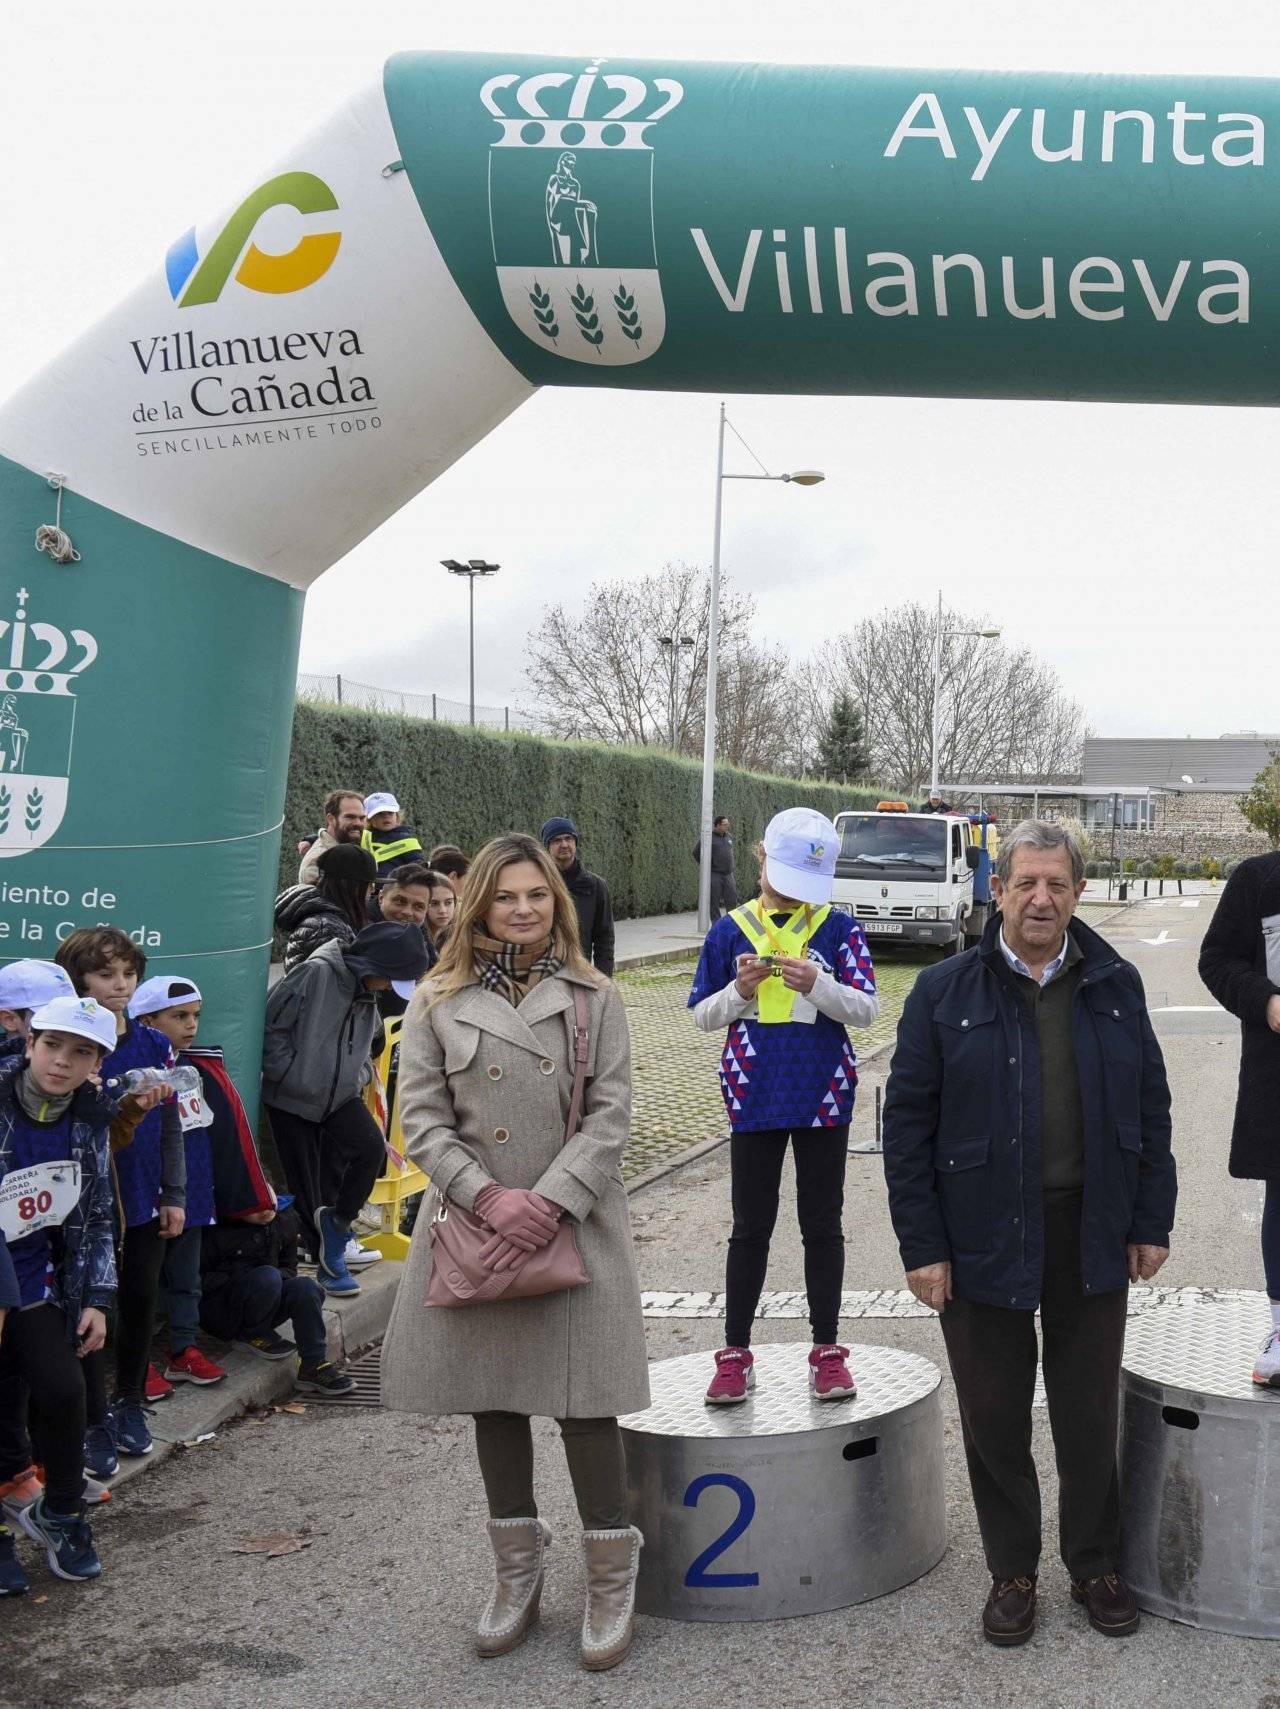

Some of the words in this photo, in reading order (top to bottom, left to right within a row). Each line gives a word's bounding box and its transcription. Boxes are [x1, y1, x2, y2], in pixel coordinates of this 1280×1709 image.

[690, 226, 1250, 324] Villanueva
[129, 328, 365, 375] Villanueva
[132, 402, 159, 423] de
[164, 400, 184, 420] la
[190, 365, 376, 417] Cañada
[136, 425, 318, 457] SENCILLAMENTE
[327, 416, 382, 435] TODO
[82, 887, 116, 909] de
[20, 918, 43, 940] la
[886, 924, 900, 932] FGP
[18, 1190, 52, 1220] 80
[684, 1474, 759, 1588] 2
